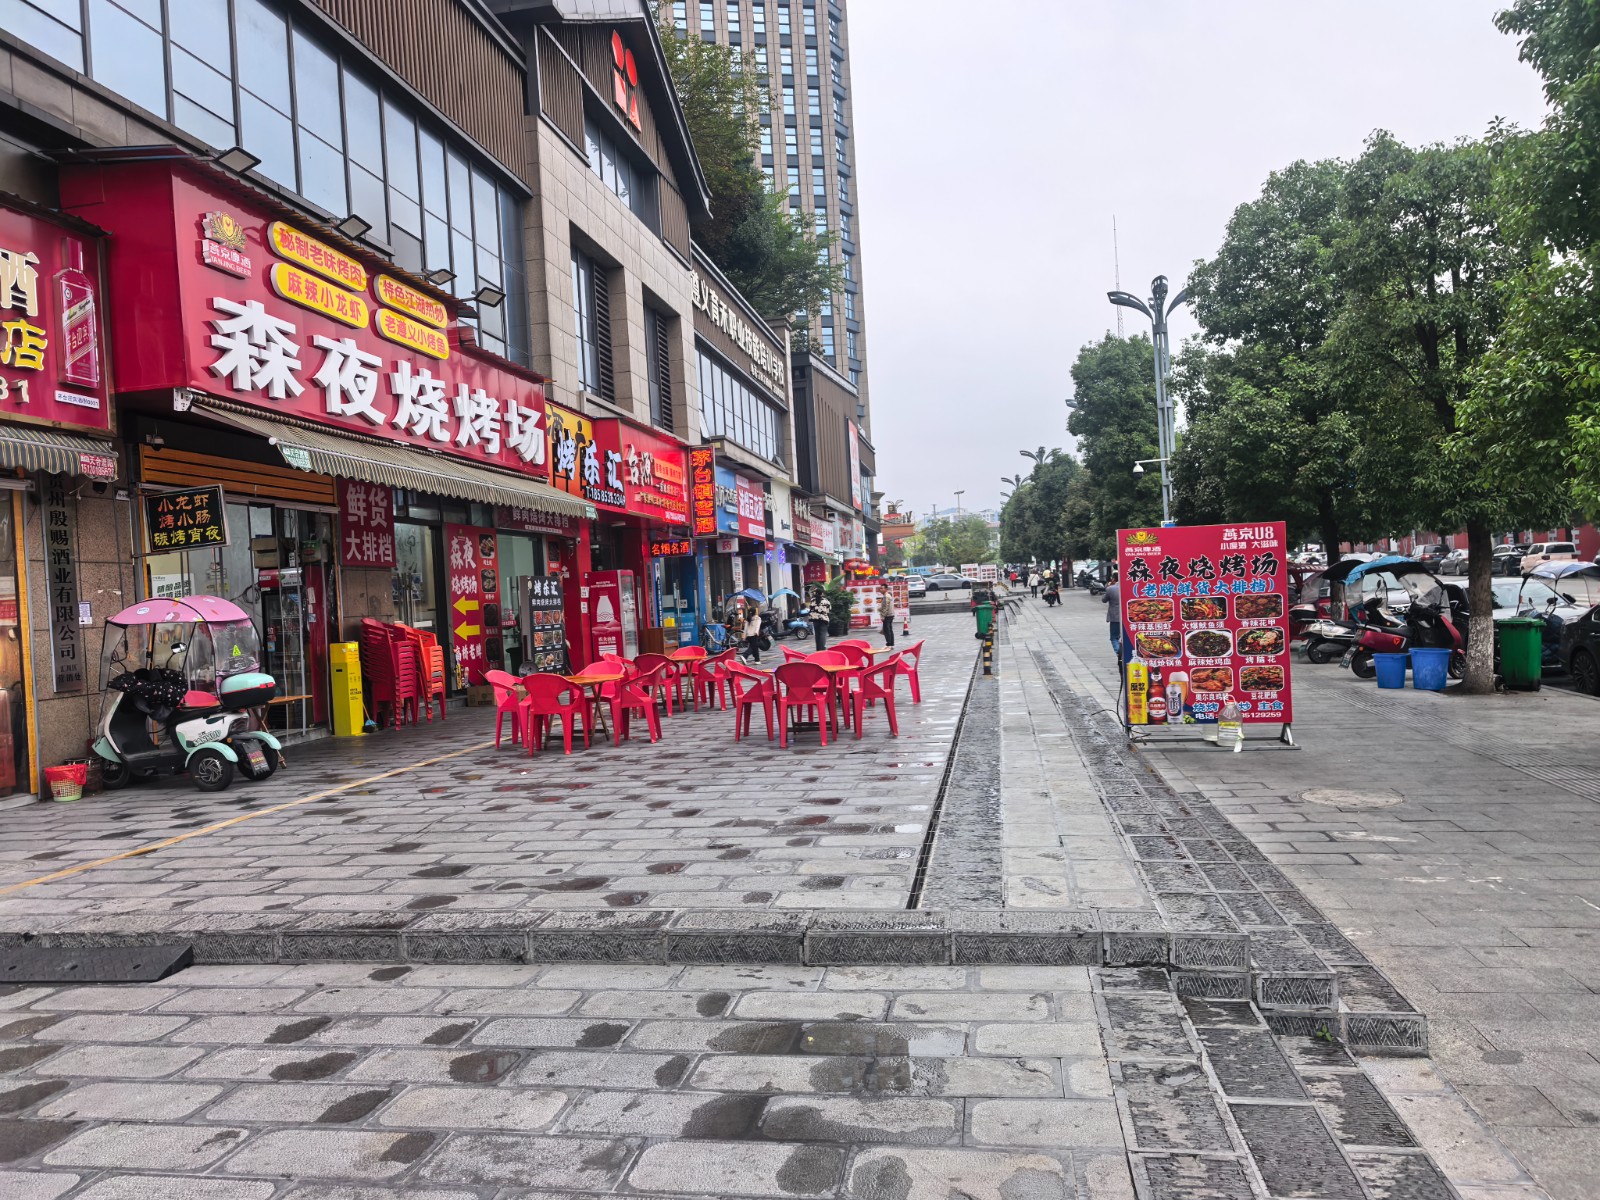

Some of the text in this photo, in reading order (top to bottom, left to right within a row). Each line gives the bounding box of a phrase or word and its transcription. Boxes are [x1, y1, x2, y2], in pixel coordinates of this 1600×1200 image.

[210, 242, 251, 269] 燕京啤酒
[279, 228, 364, 286] 秘制老味烤肉
[287, 271, 362, 322] 麻辣小龙虾
[383, 279, 445, 323] 特色江湖热炒
[385, 315, 447, 354] 老遵义小烤鱼
[210, 297, 546, 465] 森夜烧烤场
[157, 493, 209, 513] 小龙虾
[346, 484, 388, 528] 鲜货
[159, 510, 212, 529] 烤小肠
[153, 525, 222, 547] 碳烤宵夜
[1222, 527, 1275, 541] 燕京U8
[1251, 540, 1279, 549] 大滋味
[346, 531, 394, 563] 大排档
[450, 536, 477, 570] 森夜
[652, 541, 689, 555] 名烟名酒
[1126, 551, 1279, 583] 森夜烧烤场
[451, 574, 478, 595] 烧烤场
[1241, 619, 1276, 627] 香辣花甲
[1245, 655, 1277, 664] 烤脑花
[1192, 701, 1219, 712] 烧烤
[1257, 700, 1284, 711] 主食
[1251, 691, 1278, 699] 豆花肥肠
